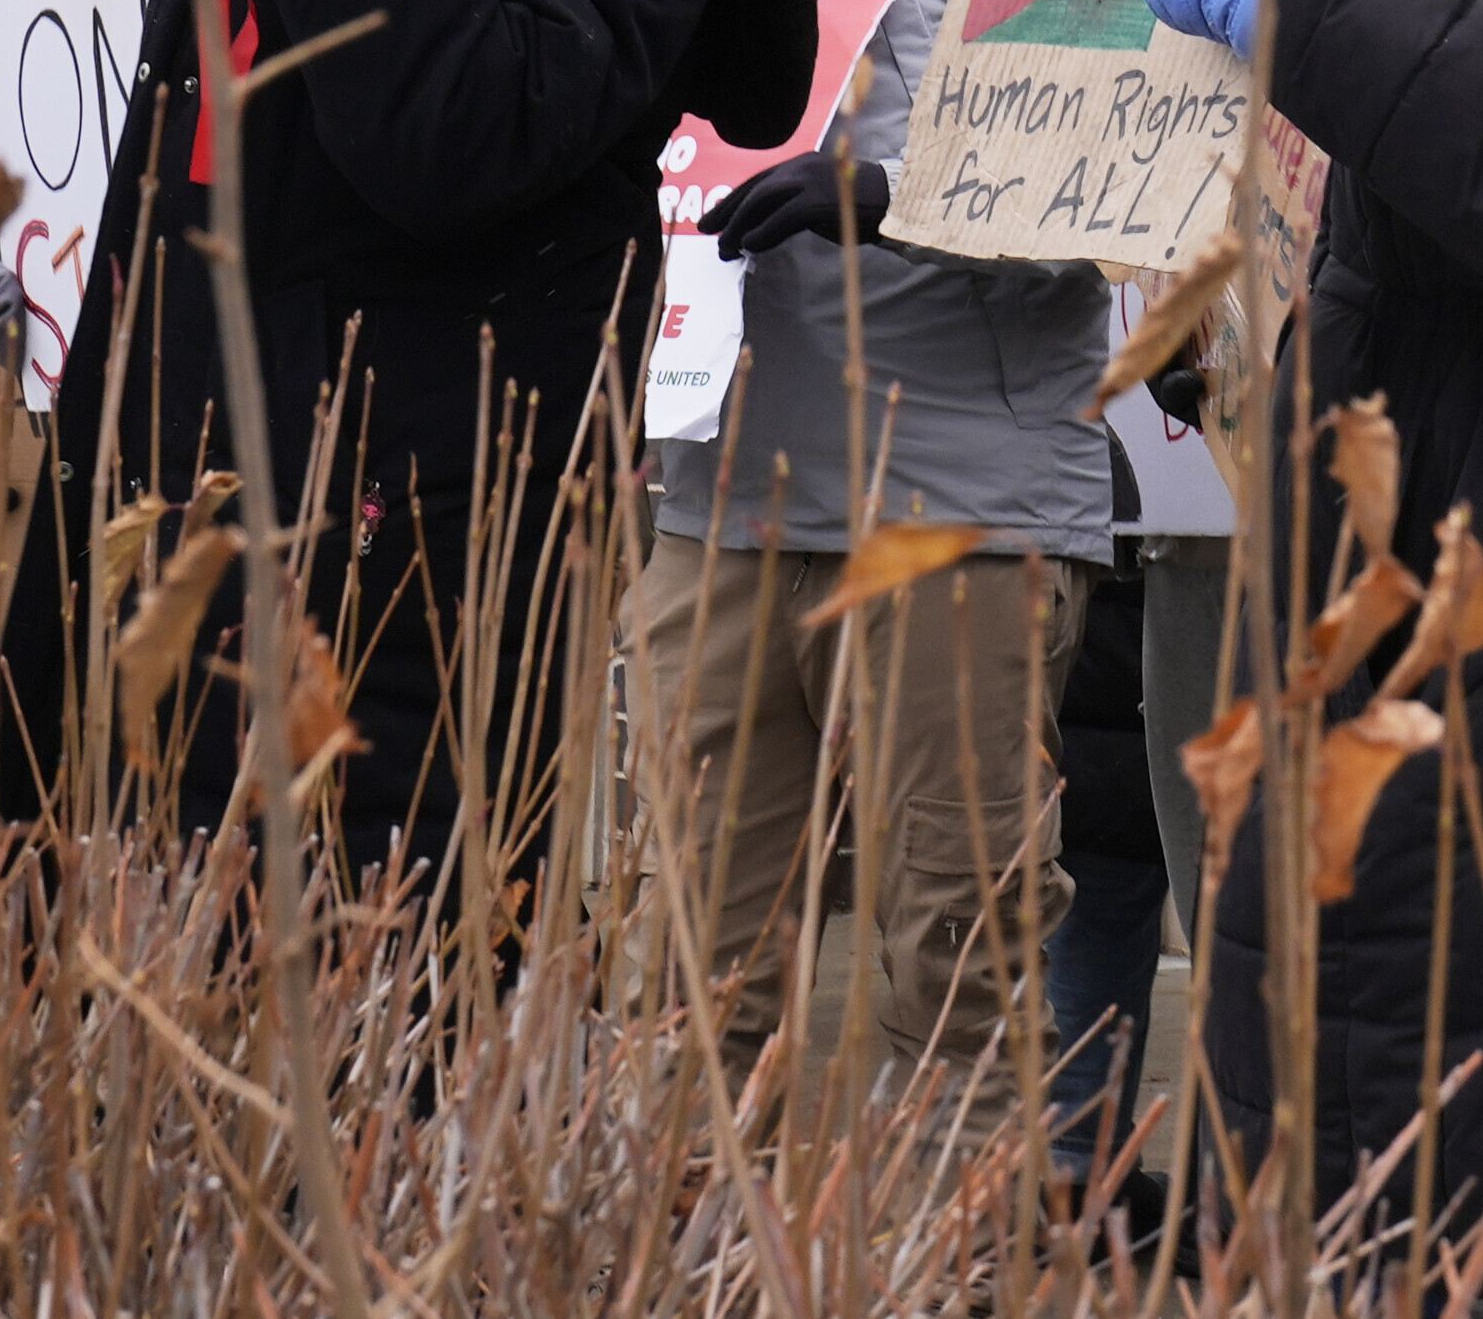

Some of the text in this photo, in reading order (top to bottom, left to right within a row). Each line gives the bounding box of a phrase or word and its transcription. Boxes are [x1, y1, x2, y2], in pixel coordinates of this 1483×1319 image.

[935, 66, 1246, 165] Human Rights
[941, 148, 1024, 222] for
[656, 370, 710, 386] UNITED
